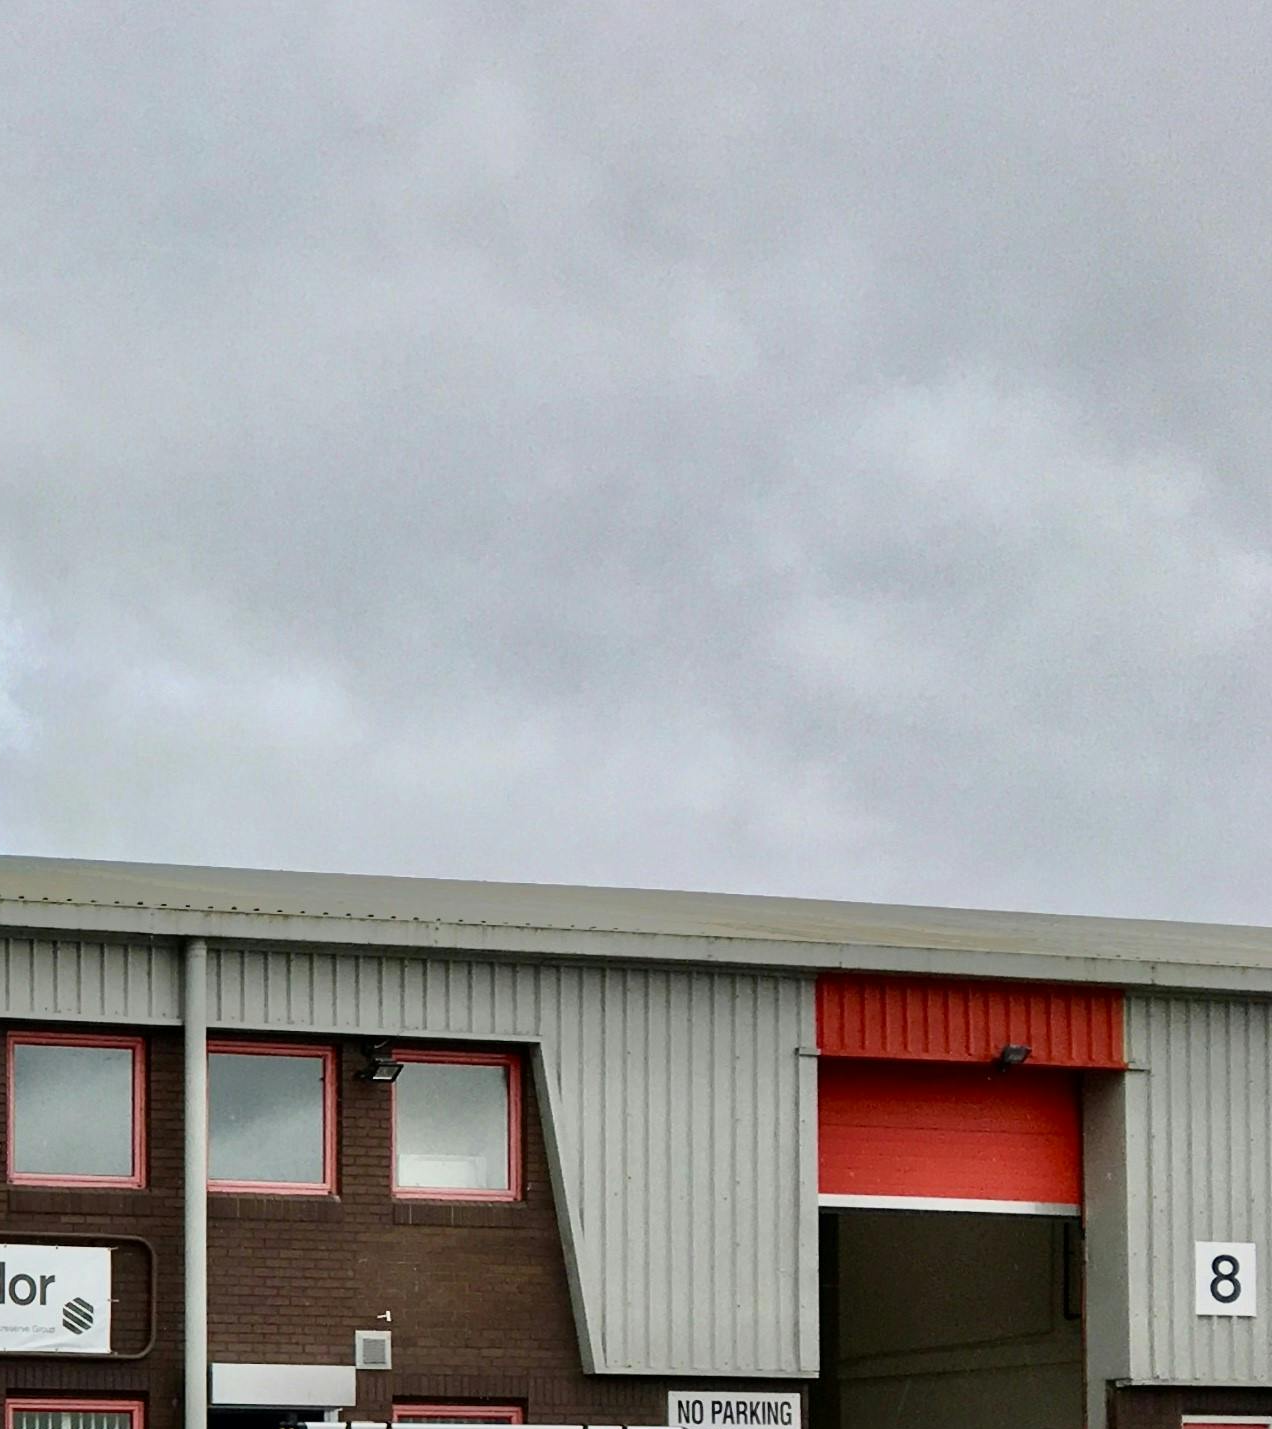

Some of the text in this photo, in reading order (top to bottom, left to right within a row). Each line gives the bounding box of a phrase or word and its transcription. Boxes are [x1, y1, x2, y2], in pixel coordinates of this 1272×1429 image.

[1210, 1254, 1241, 1303] 8
[678, 1400, 792, 1425] NO PARKING
